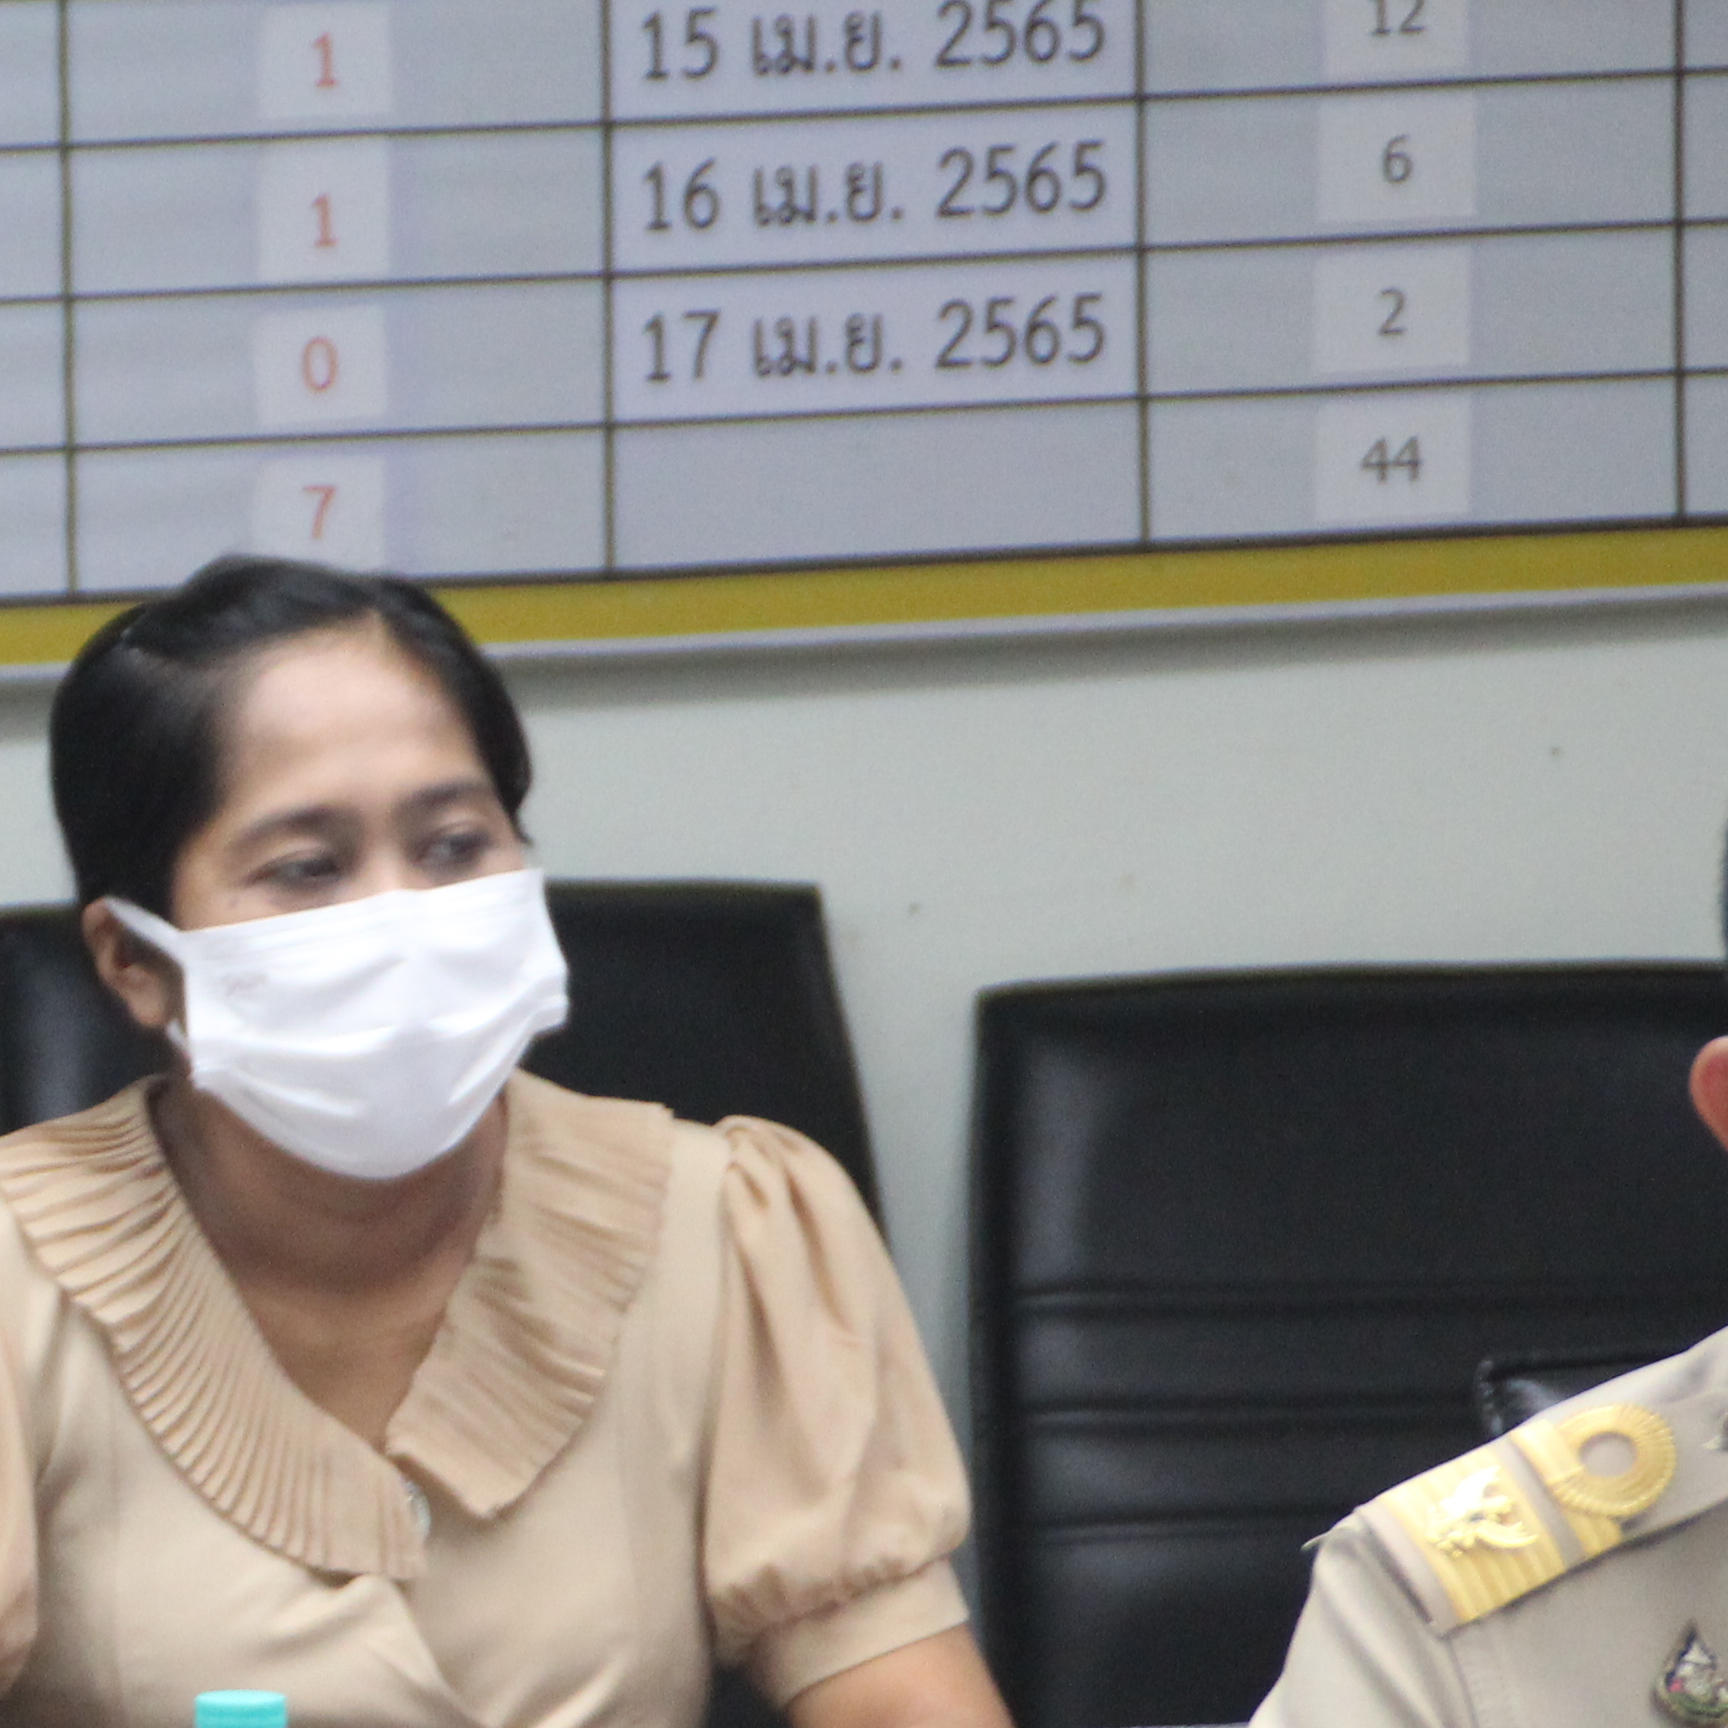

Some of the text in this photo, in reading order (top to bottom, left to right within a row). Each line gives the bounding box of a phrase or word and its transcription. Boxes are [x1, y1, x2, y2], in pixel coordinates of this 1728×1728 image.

[643, 0, 1106, 83] 15 เม.ย. 2565
[1371, 0, 1426, 39] 12
[313, 33, 338, 91] 1
[645, 140, 1107, 234] 16 เม.ย. 2565
[1381, 135, 1414, 187] 6
[312, 194, 337, 250] 1
[645, 293, 1106, 386] 17 เม.ย. 2565
[1377, 287, 1409, 339] 2
[300, 336, 340, 396] 0
[1361, 437, 1423, 483] 44
[301, 484, 339, 540] 7
